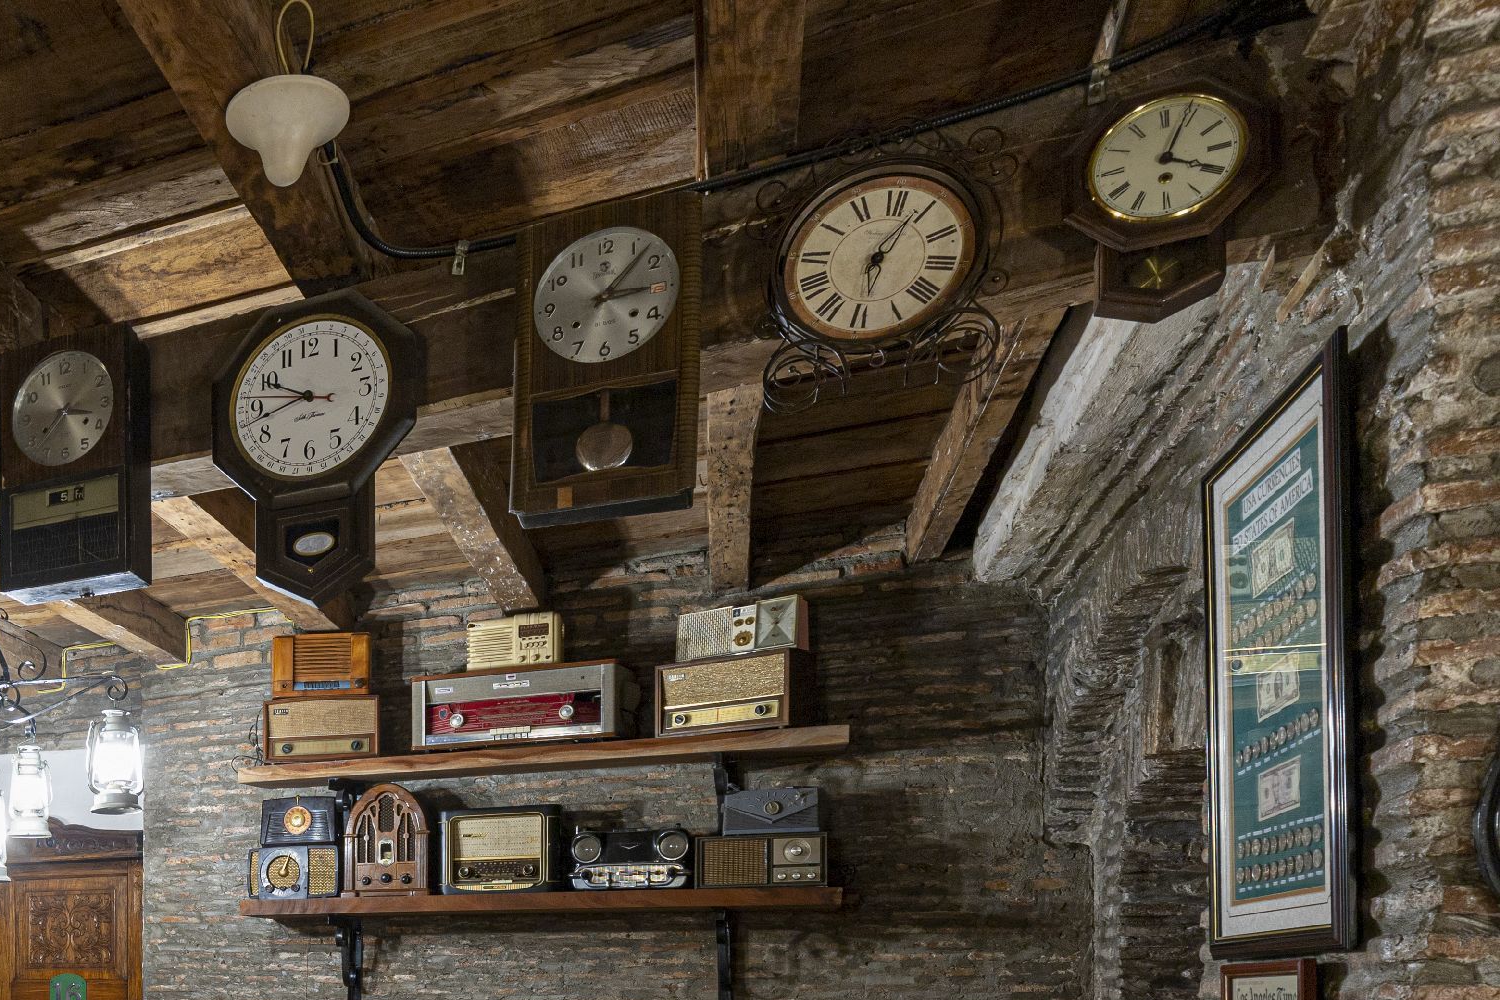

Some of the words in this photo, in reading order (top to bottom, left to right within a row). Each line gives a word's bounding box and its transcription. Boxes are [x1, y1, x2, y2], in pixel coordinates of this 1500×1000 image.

[598, 240, 614, 256] 12
[572, 253, 583, 268] 11
[648, 254, 660, 270] 2
[551, 275, 568, 292] 10
[545, 303, 556, 318] 9
[646, 305, 661, 320] 4
[552, 326, 564, 341] 8
[628, 328, 639, 345] 5
[301, 337, 319, 359] 12
[333, 338, 338, 357] 1
[571, 340, 585, 355] 7
[599, 340, 611, 356] 6
[282, 349, 292, 369] 11
[350, 352, 363, 373] 2
[261, 371, 278, 391] 10
[358, 376, 372, 397] 3
[250, 399, 264, 419] 9
[347, 405, 364, 426] 4
[259, 424, 271, 444] 8
[329, 427, 342, 450] 5
[280, 437, 291, 459] 7
[304, 439, 316, 460] 6
[1243, 494, 1257, 514] USA
[1257, 451, 1300, 500] CURRENCIES
[60, 492, 68, 502] 5
[1244, 514, 1268, 541] STATES
[1269, 504, 1278, 523] OF
[1280, 474, 1312, 515] AMERICA
